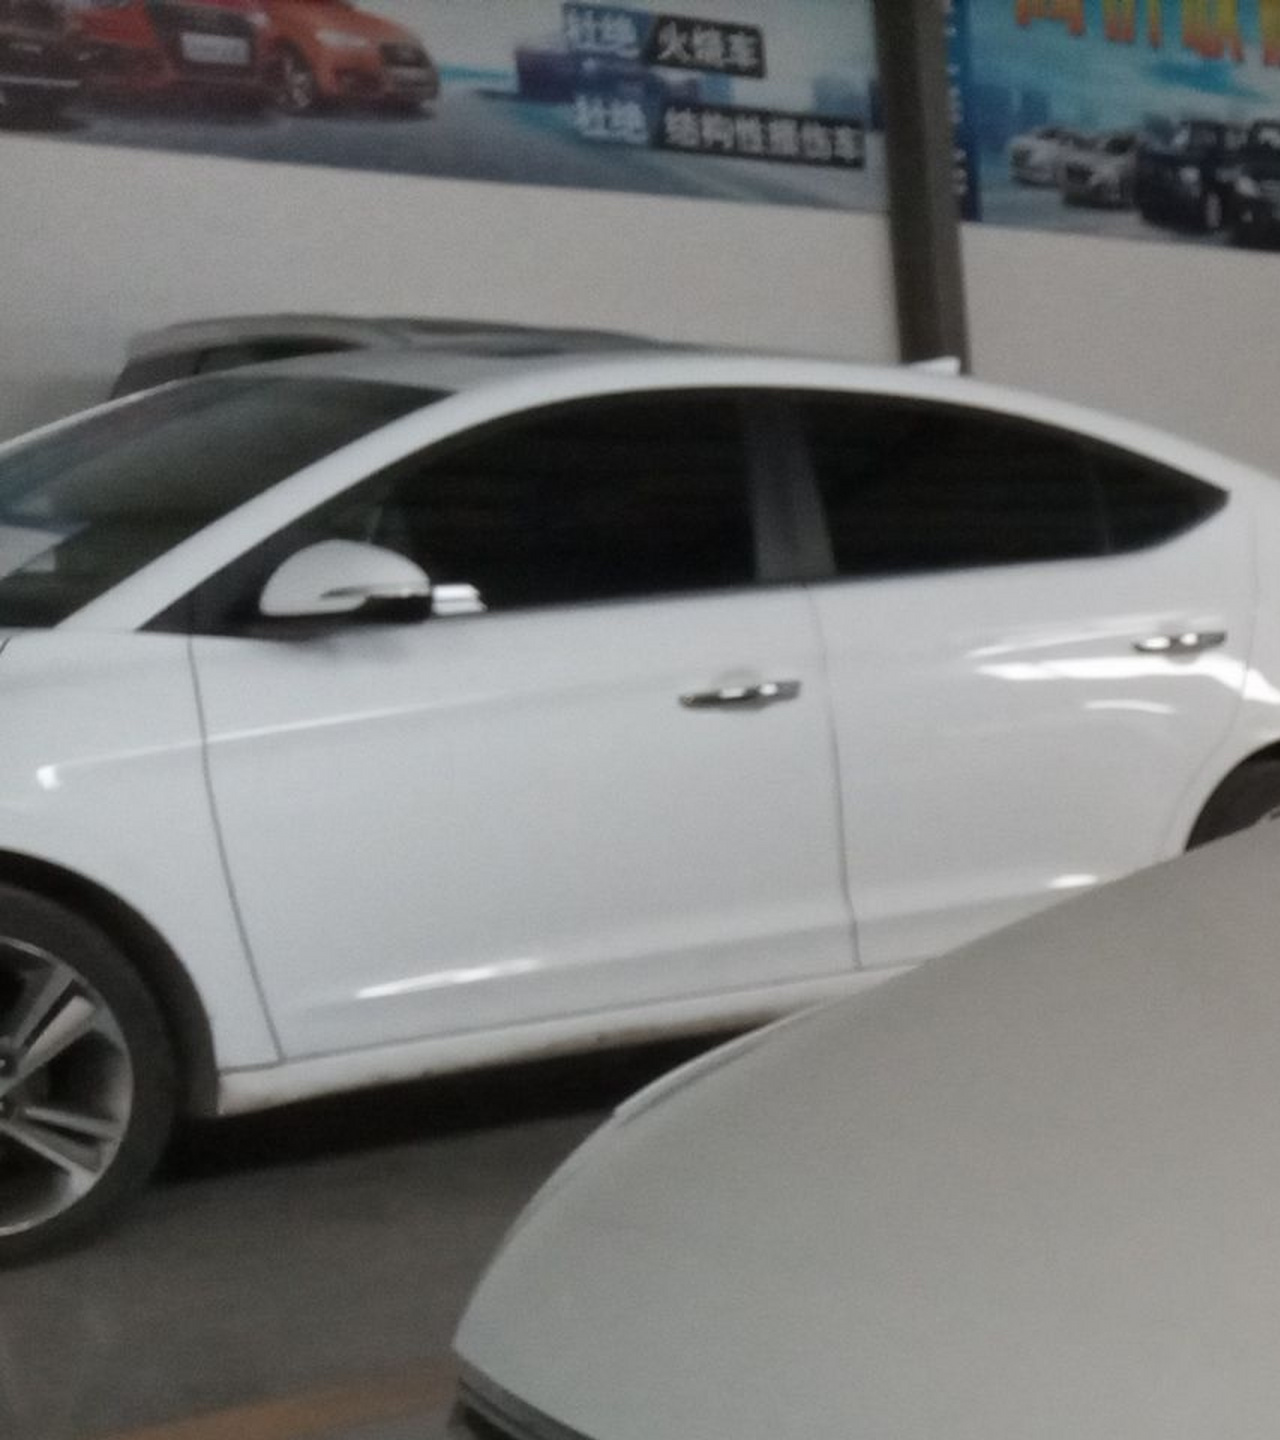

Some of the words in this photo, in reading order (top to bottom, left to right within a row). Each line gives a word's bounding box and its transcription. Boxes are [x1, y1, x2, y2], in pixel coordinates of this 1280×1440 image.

[565, 8, 638, 57] 杜绝
[656, 20, 760, 70] 火烧车
[575, 95, 648, 144] 杜绝
